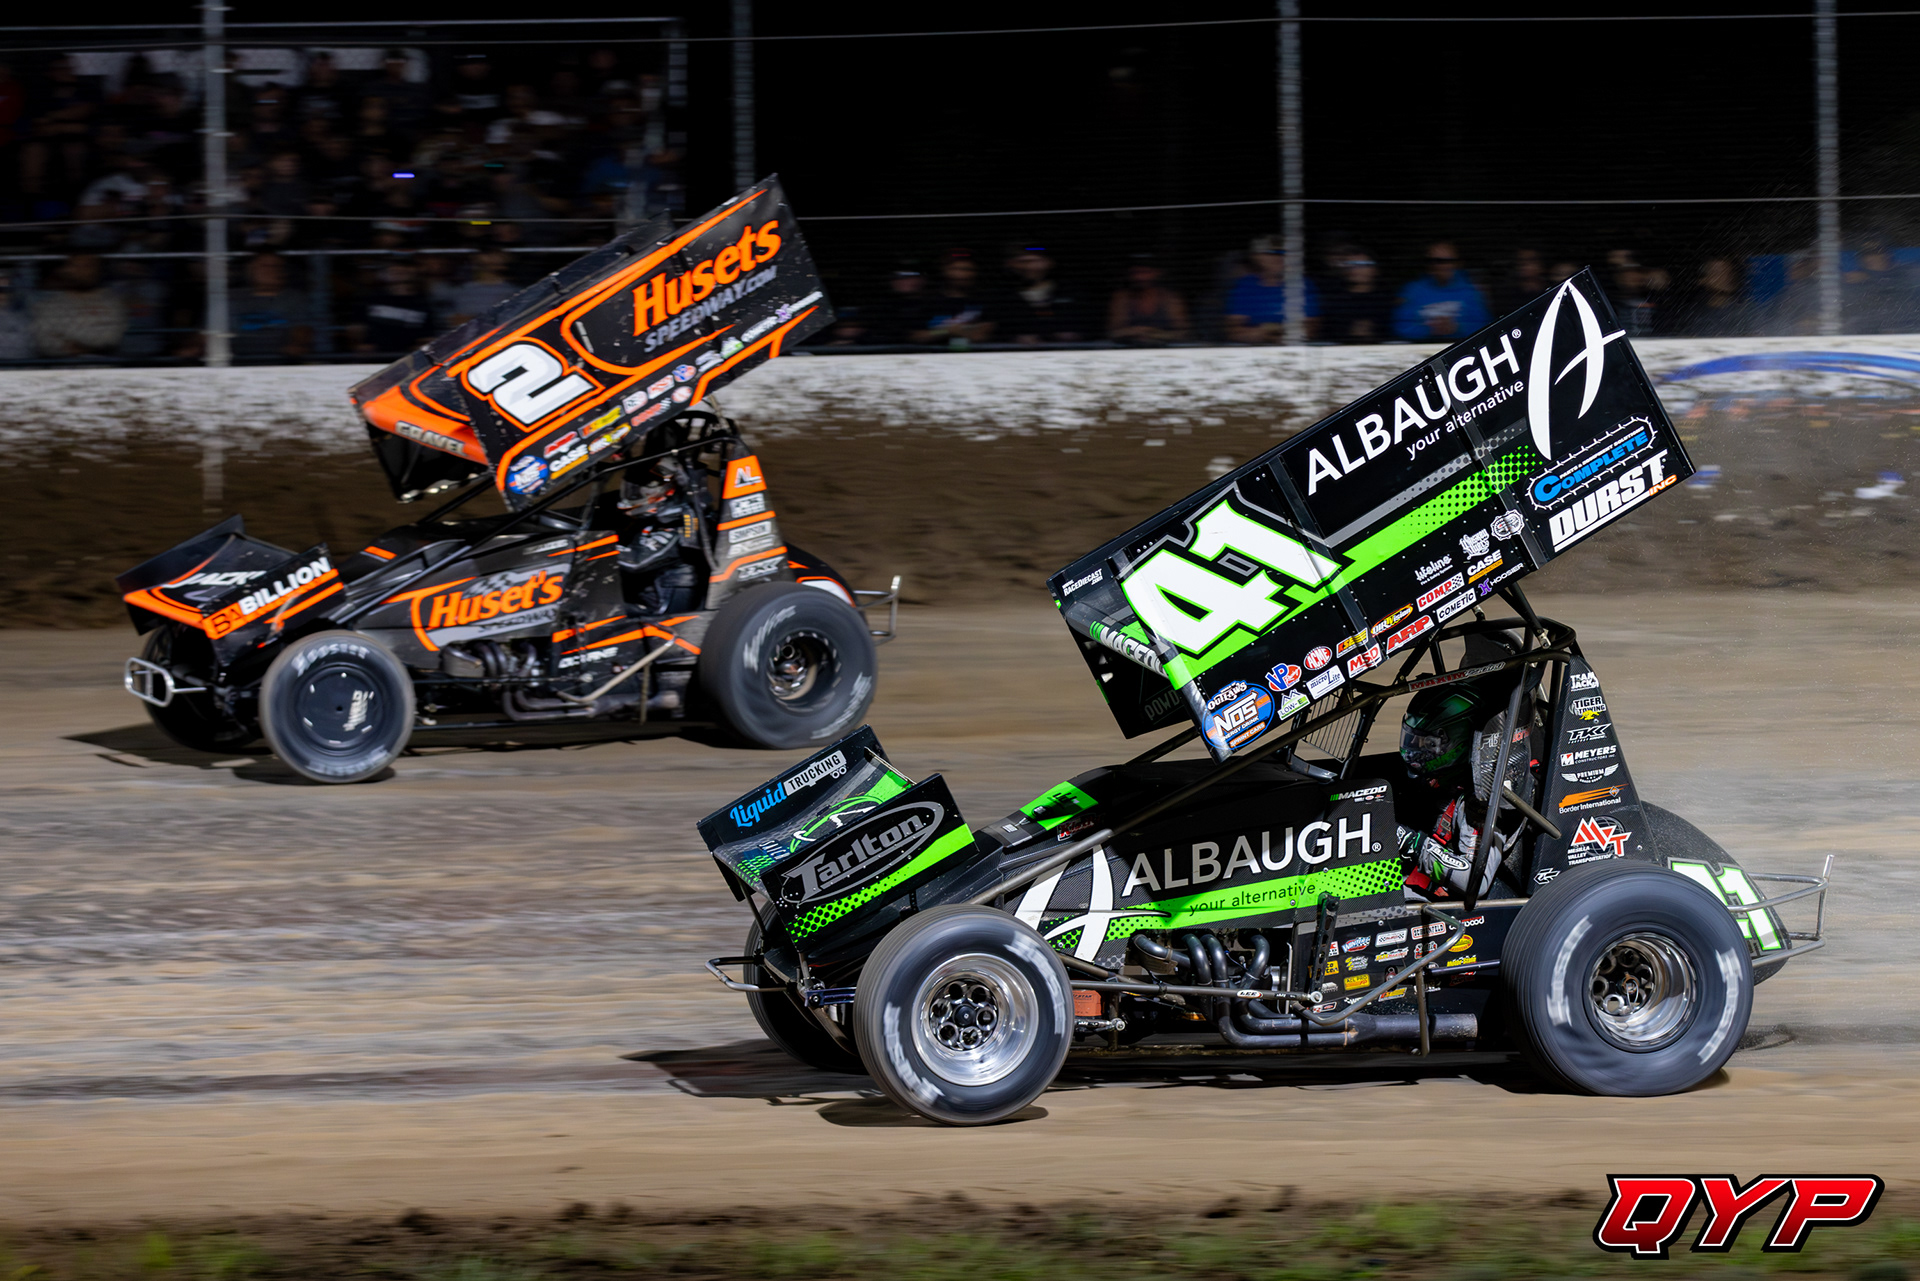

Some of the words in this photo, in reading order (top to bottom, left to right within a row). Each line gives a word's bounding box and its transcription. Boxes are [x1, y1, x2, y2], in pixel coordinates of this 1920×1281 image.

[467, 343, 595, 425] 2
[1308, 334, 1520, 496] ALBAUGH
[1405, 428, 1442, 461] your
[1445, 380, 1525, 432] alternative
[1534, 431, 1649, 502] COMPLETE
[1549, 449, 1668, 546] DURST
[1649, 475, 1677, 496] INC
[1121, 499, 1342, 655] 41
[1467, 549, 1502, 576] CASE
[1489, 562, 1524, 586] HOOSIER
[238, 557, 332, 615] BILLION
[426, 570, 564, 631] Huset's
[1418, 581, 1452, 608] COMP
[1388, 616, 1430, 650] ARP
[1306, 648, 1331, 668] ACME
[1350, 646, 1379, 672] MSD
[1266, 663, 1288, 690] VP
[1570, 671, 1595, 681] TEAM
[1571, 679, 1593, 689] JACK
[1213, 689, 1259, 738] NOS
[1575, 697, 1602, 708] TIGER
[1575, 745, 1617, 760] MEYERS
[788, 754, 841, 790] TRUCKING
[730, 781, 788, 827] Liquid
[1338, 785, 1388, 800] MACEDO
[1559, 805, 1580, 814] Border
[1580, 796, 1622, 810] International
[782, 813, 925, 901] Tarlton
[1121, 812, 1372, 898] ALBAUGH
[1190, 897, 1226, 916] your
[1232, 883, 1316, 908] alternative
